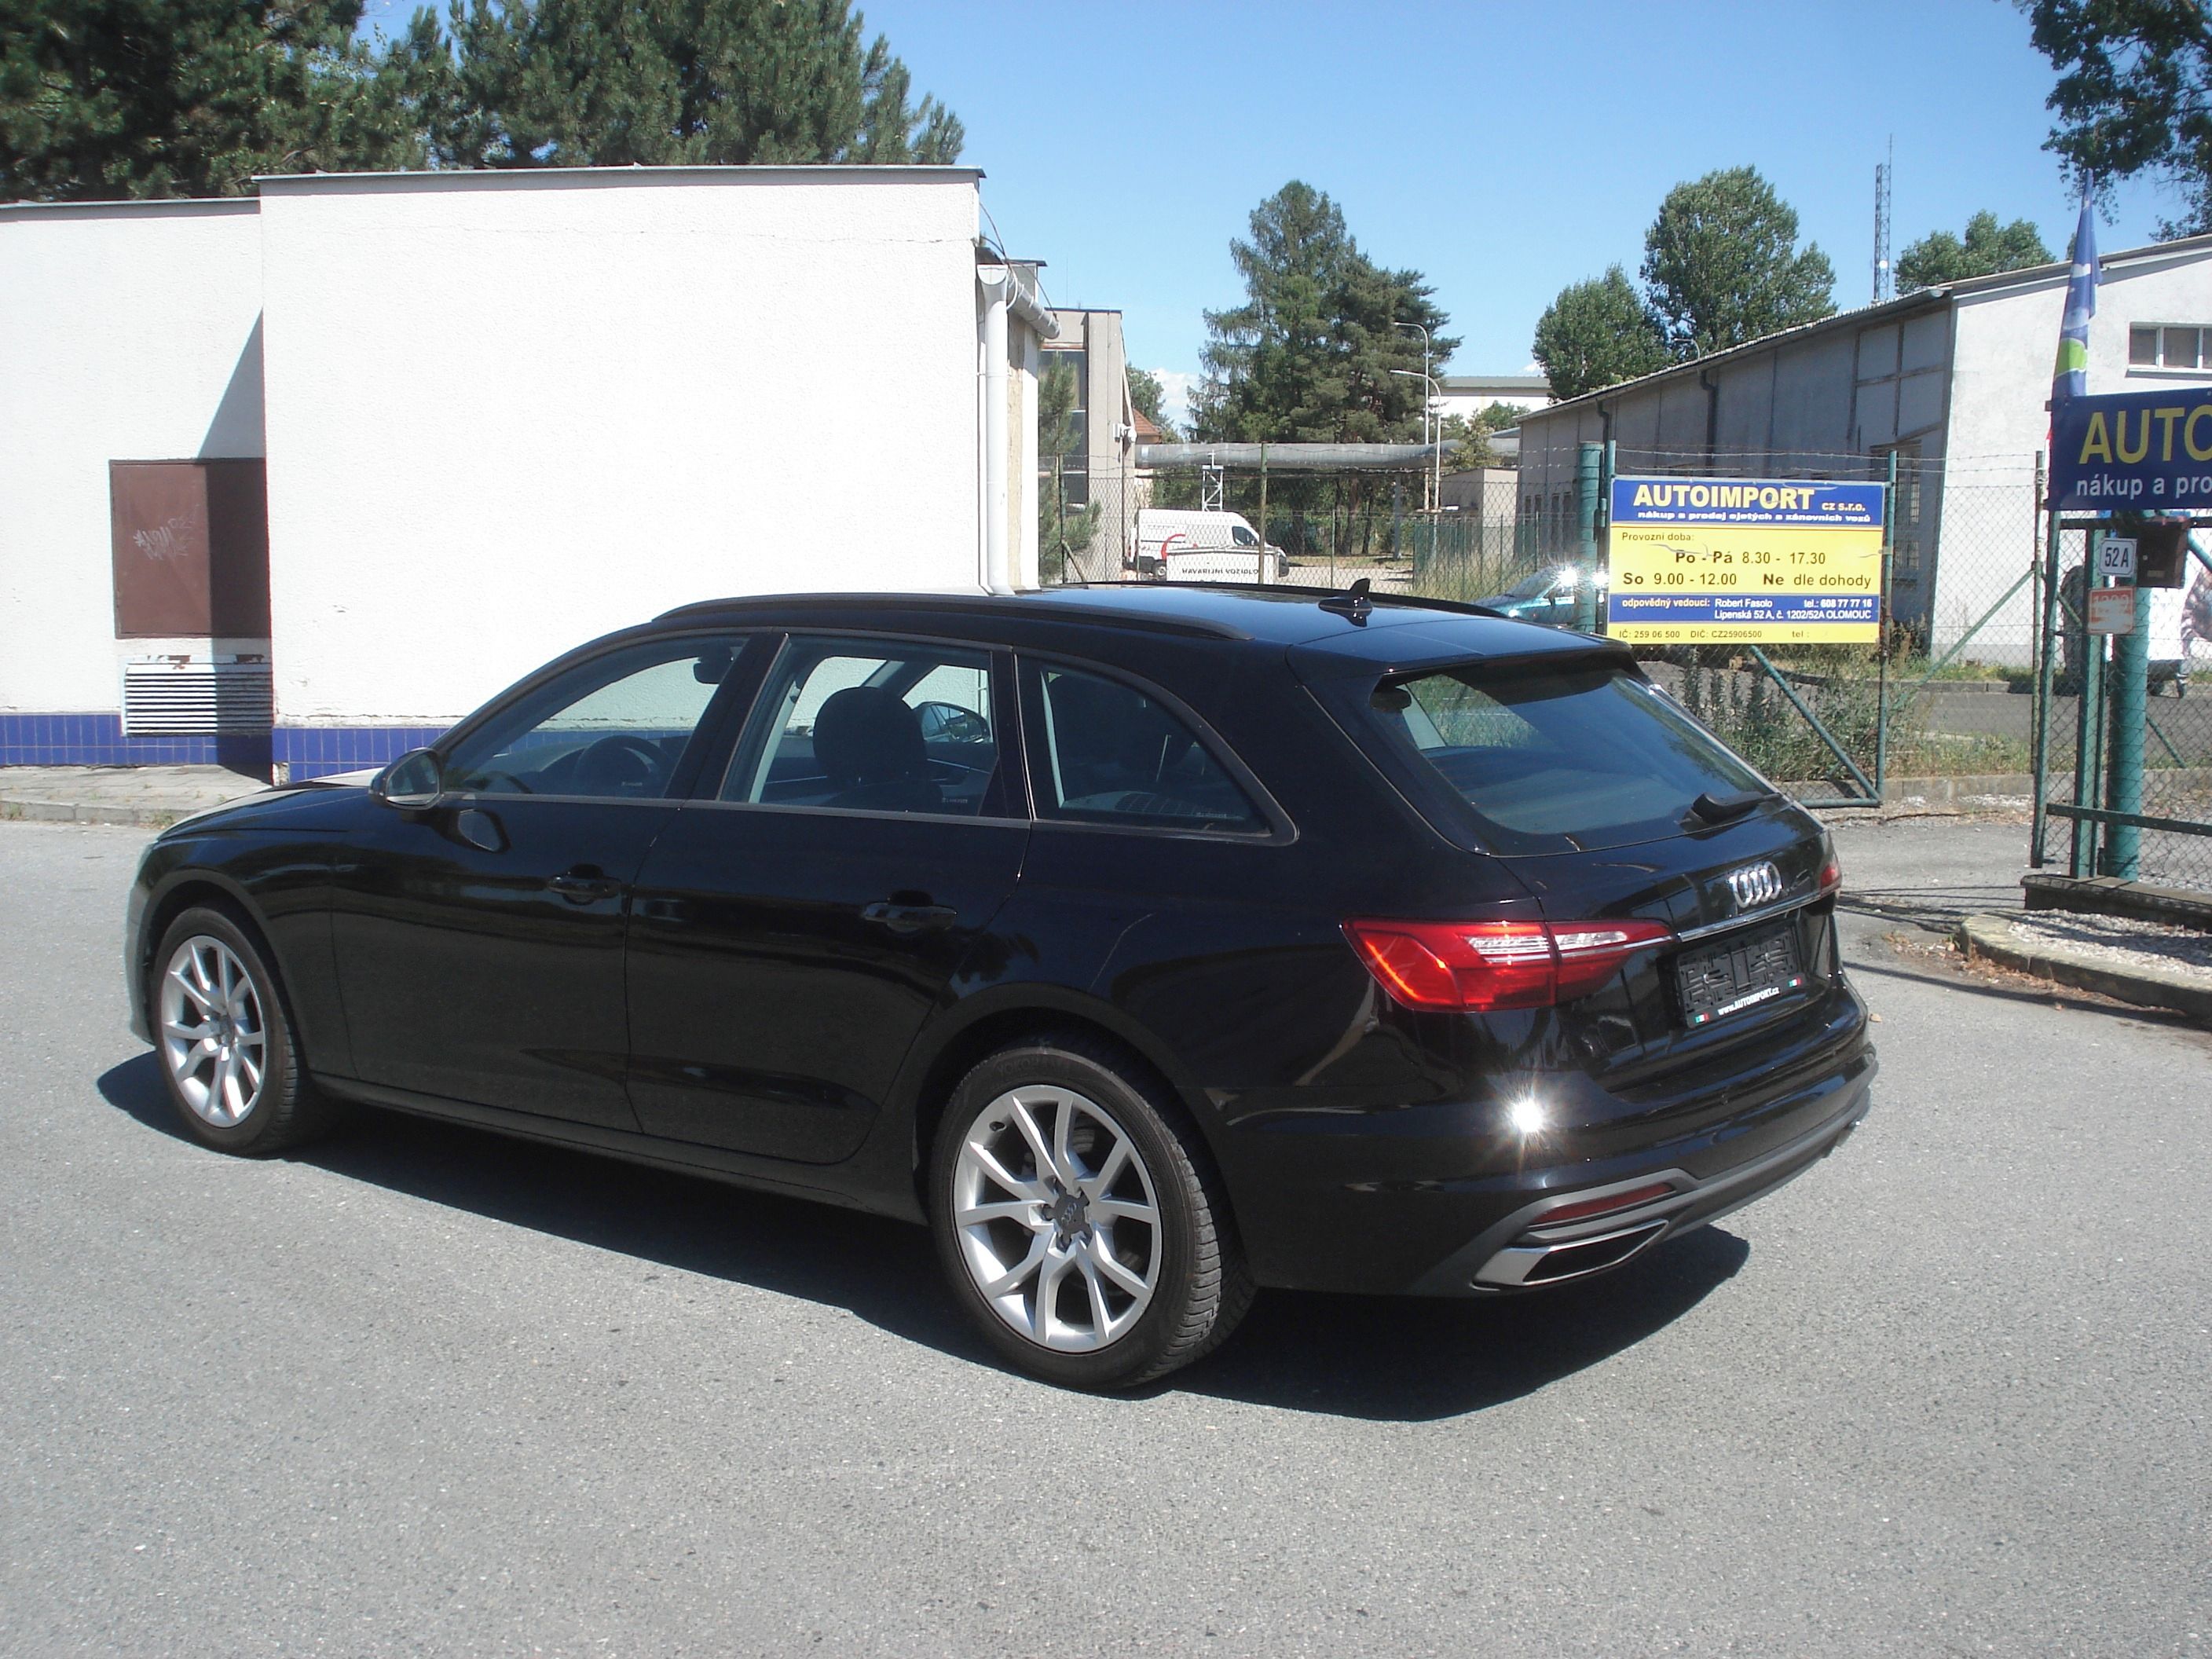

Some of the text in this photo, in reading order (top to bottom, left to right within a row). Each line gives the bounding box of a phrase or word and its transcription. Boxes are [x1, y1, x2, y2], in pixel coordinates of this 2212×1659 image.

[2078, 405, 2212, 464] AUTO
[2076, 474, 2212, 500] nákup a pro
[1633, 484, 1866, 511] AUTOIMPORT cz s.r.o.
[1638, 511, 1675, 520] nákup
[1689, 511, 1727, 521] prodej
[1622, 532, 1694, 541] Provozní doba:
[1675, 549, 1696, 563] Po
[1712, 551, 1733, 563] Pá
[1741, 551, 1771, 564] 8.30
[1789, 551, 1826, 565] 17.30
[1623, 572, 1644, 585] So
[1654, 573, 1684, 585] 9.00
[1700, 573, 1737, 585] 12.00
[1763, 573, 1871, 589] Ne dle dohody
[1622, 598, 1671, 609] odpovědný
[1715, 598, 1742, 607] Robert
[1837, 599, 1848, 608] 77
[1850, 599, 1861, 608] 77
[1714, 610, 1752, 620] Lipenská
[1787, 610, 1825, 619] 1202/52A
[1826, 610, 1872, 619] OLOMOUC
[1619, 629, 1632, 638] IČ:
[1690, 629, 1709, 638] DIČ:
